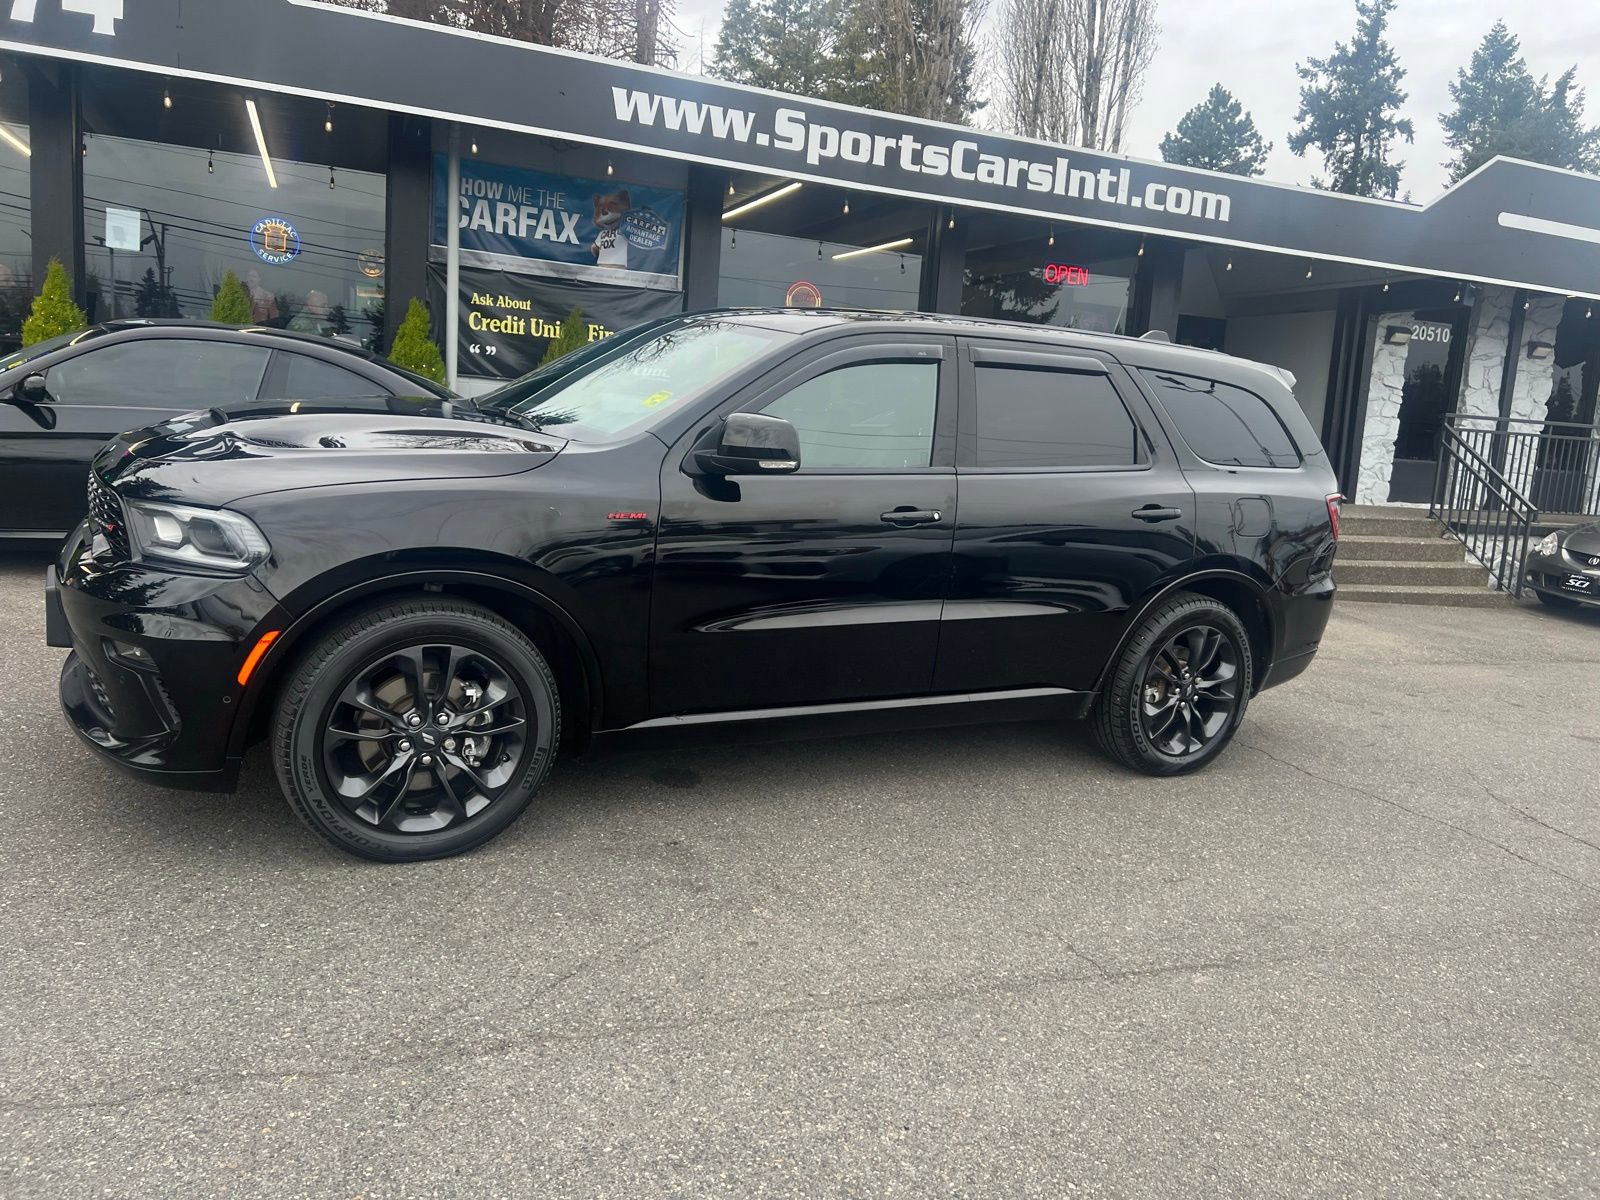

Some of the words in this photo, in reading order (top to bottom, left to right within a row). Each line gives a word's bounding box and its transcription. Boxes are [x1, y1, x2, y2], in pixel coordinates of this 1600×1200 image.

[612, 86, 1231, 222] www.SportsCarsIntl.com
[460, 178, 503, 199] HOW
[508, 184, 533, 205] ME
[536, 189, 567, 210] THE
[255, 219, 297, 238] CADILLAC
[626, 216, 667, 236] CARFAX
[626, 225, 661, 242] ADVANTAGE
[600, 239, 615, 250] FOX
[629, 234, 653, 247] DEALER
[258, 248, 293, 263] SERVICE
[1045, 264, 1089, 287] OPEN
[470, 292, 494, 307] Ask
[496, 295, 532, 311] About
[468, 311, 526, 335] Credit
[530, 317, 561, 339] Uni
[1411, 325, 1450, 343] 20510
[1131, 683, 1148, 753] COOPER
